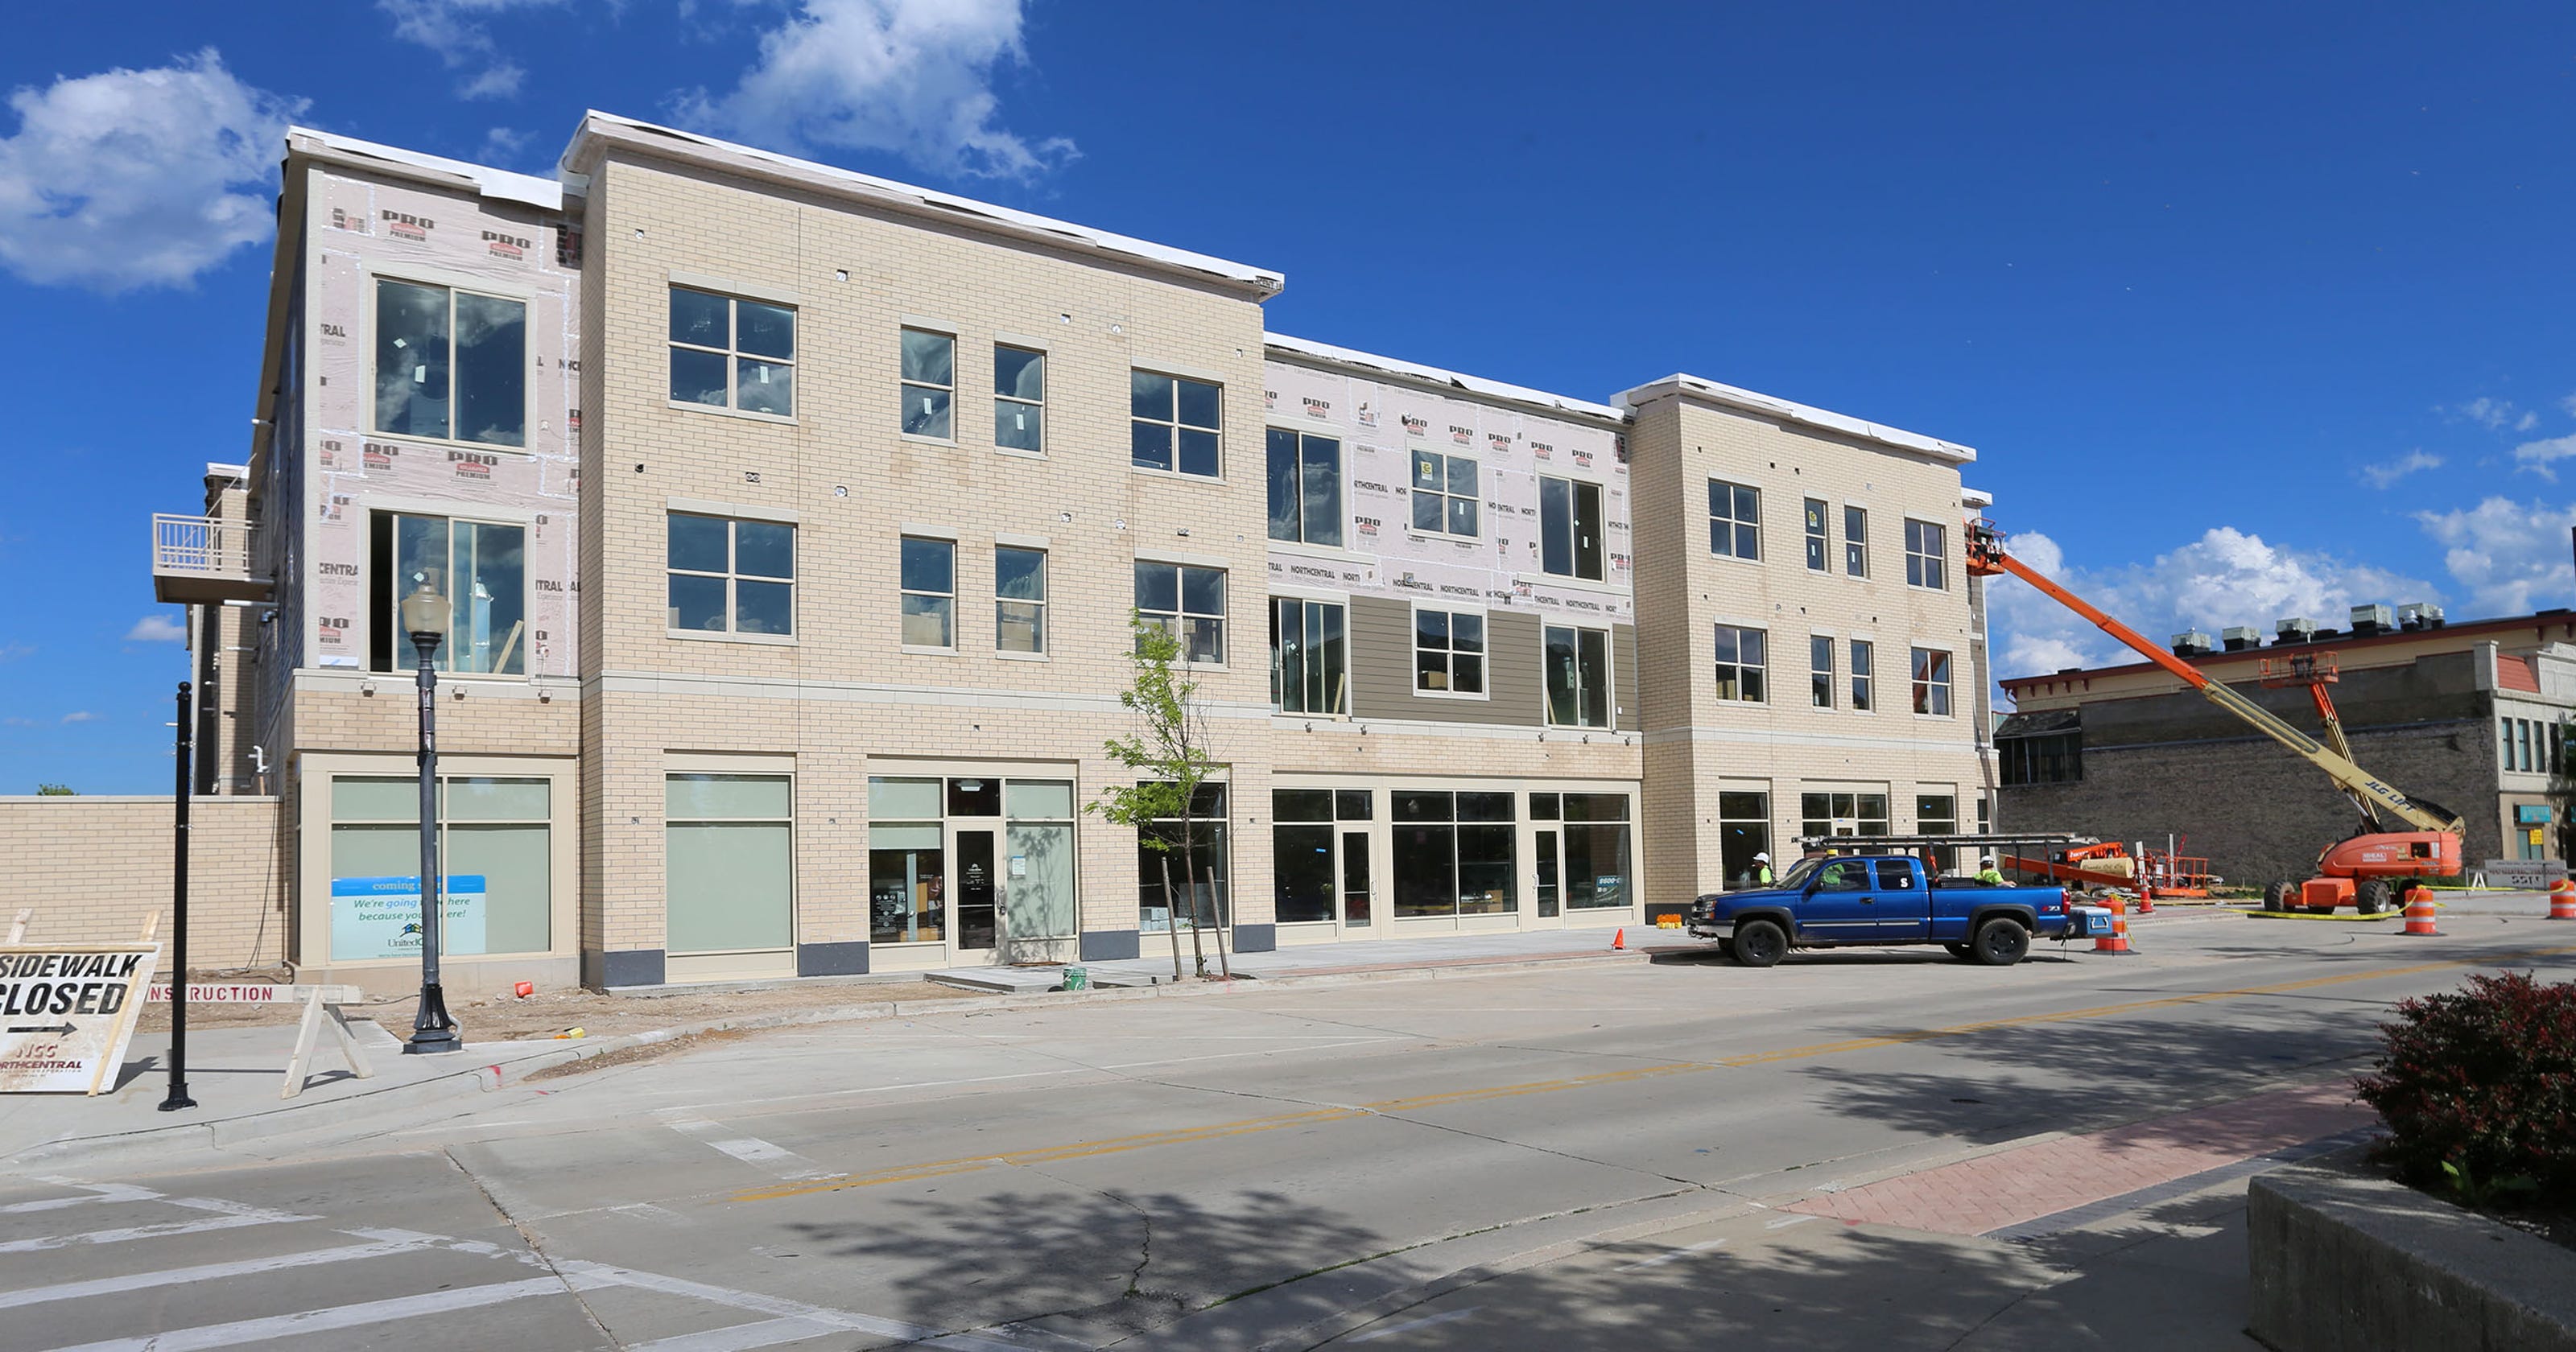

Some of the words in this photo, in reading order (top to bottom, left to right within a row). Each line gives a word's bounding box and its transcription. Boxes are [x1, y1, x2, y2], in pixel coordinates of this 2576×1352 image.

[382, 209, 435, 229] PRO
[390, 230, 426, 242] PREMIUM
[481, 230, 530, 249] PRO
[489, 250, 522, 262] PREMIUM
[1302, 397, 1330, 410] PRO
[1449, 425, 1473, 437] PRO
[1488, 433, 1512, 444] PRO
[1531, 441, 1554, 452] PRO
[448, 451, 497, 466] PRO
[1572, 449, 1593, 460] PRO
[456, 471, 490, 480] PREMIUM
[1355, 516, 1381, 527] PRO
[1290, 565, 1335, 579] NORTHCENTRAL
[1440, 584, 1480, 597] NORTHCENTRAL
[2365, 781, 2390, 795] JLG
[2388, 793, 2417, 812] LIFT
[373, 880, 415, 892] coming
[354, 900, 384, 909] We're
[386, 899, 418, 909] going
[359, 912, 403, 921] because
[0, 954, 143, 979] SIDEWALK
[150, 987, 273, 1001] NSRUCTION
